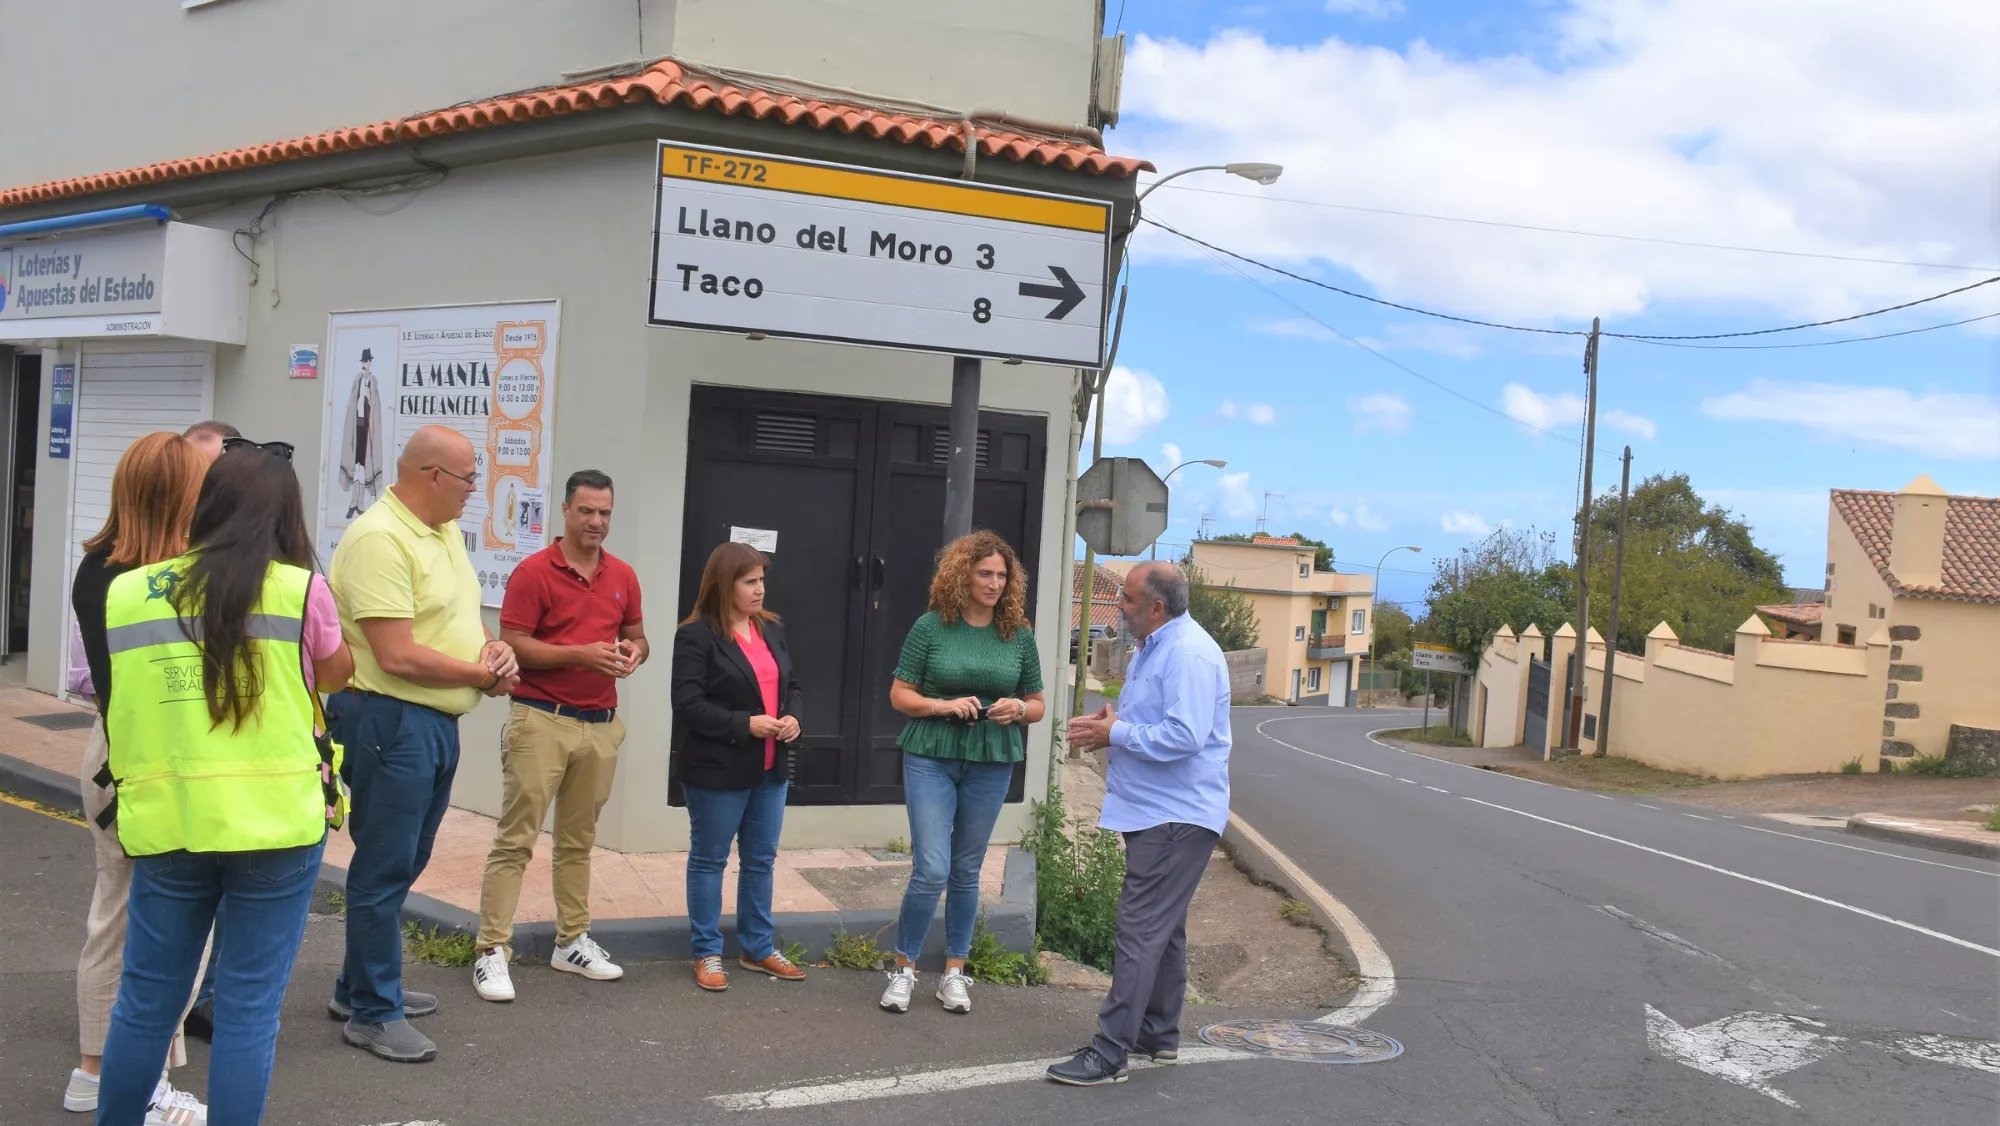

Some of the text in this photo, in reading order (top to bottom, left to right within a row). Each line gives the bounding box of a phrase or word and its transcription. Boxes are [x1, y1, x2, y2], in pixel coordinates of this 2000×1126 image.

[683, 154, 767, 182] TF-272
[678, 206, 996, 270] Llano del Moro 3
[18, 250, 82, 280] Loterías y
[16, 273, 154, 314] Apuestas del Estado
[676, 263, 992, 324] Taco 8
[106, 320, 152, 332] ADMINISTRACIÓN
[524, 333, 537, 341] 1975
[402, 360, 490, 386] LA MANTA
[499, 384, 511, 392] 9:00
[519, 384, 534, 392] 13:00
[521, 394, 537, 402] 20:00
[400, 395, 489, 416] ESPERANCERA
[504, 436, 526, 444] Sábados
[498, 446, 509, 455] 9:00
[516, 448, 531, 456] 13:00
